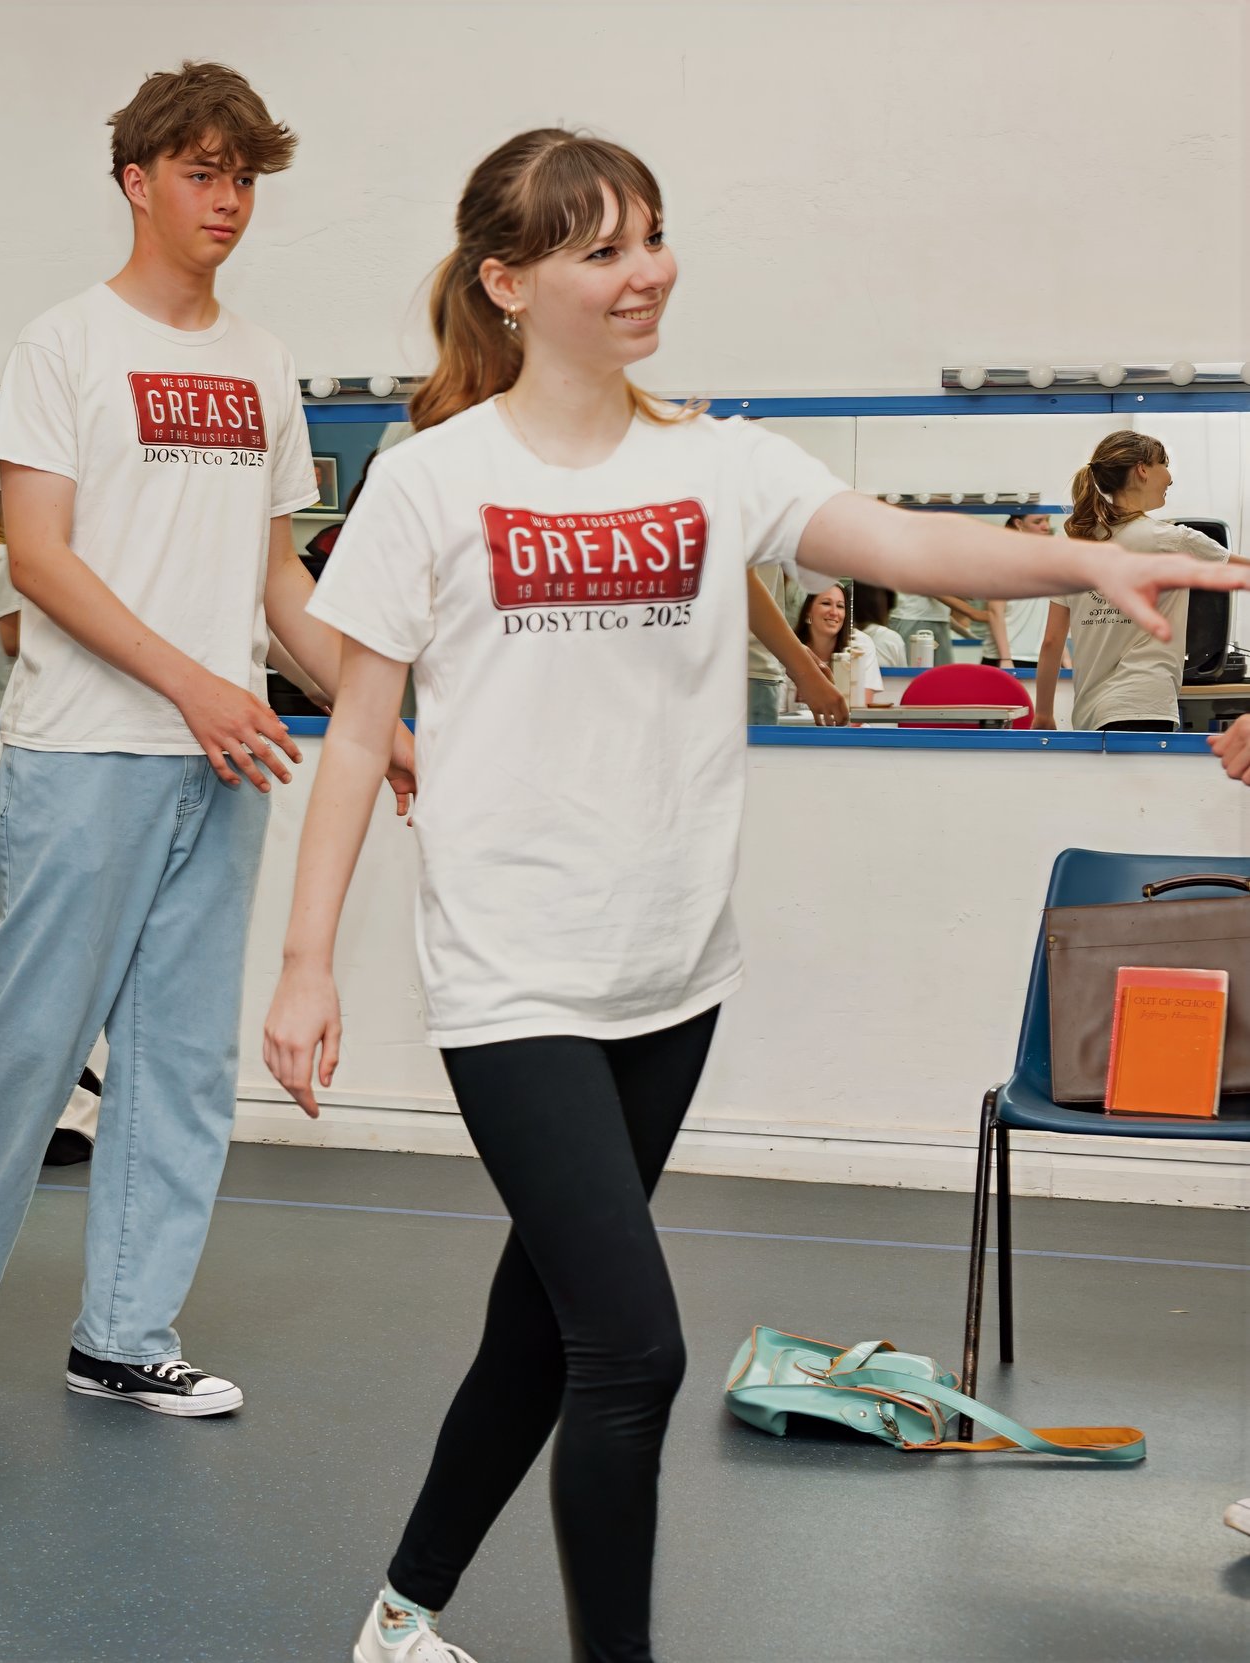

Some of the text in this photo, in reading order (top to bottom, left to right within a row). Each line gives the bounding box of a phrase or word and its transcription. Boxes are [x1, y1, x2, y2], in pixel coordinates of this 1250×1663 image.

[161, 378, 235, 391] WE GO TOGETHER
[147, 389, 259, 430] GREASE
[154, 429, 163, 439] 19
[170, 430, 189, 440] THE
[194, 432, 242, 443] MUSICAL
[143, 448, 265, 467] DOSYTCo 2025
[531, 509, 655, 529] WE GO TOGETHER
[508, 517, 697, 576] GREASE
[518, 584, 532, 599] 19
[545, 582, 575, 597] THE
[587, 580, 666, 597] MUSICAL
[503, 603, 692, 636] DOSYTCo 2025
[1133, 997, 1157, 1006] OUT
[1158, 998, 1174, 1006] OF
[1175, 999, 1219, 1008] SCHOOL
